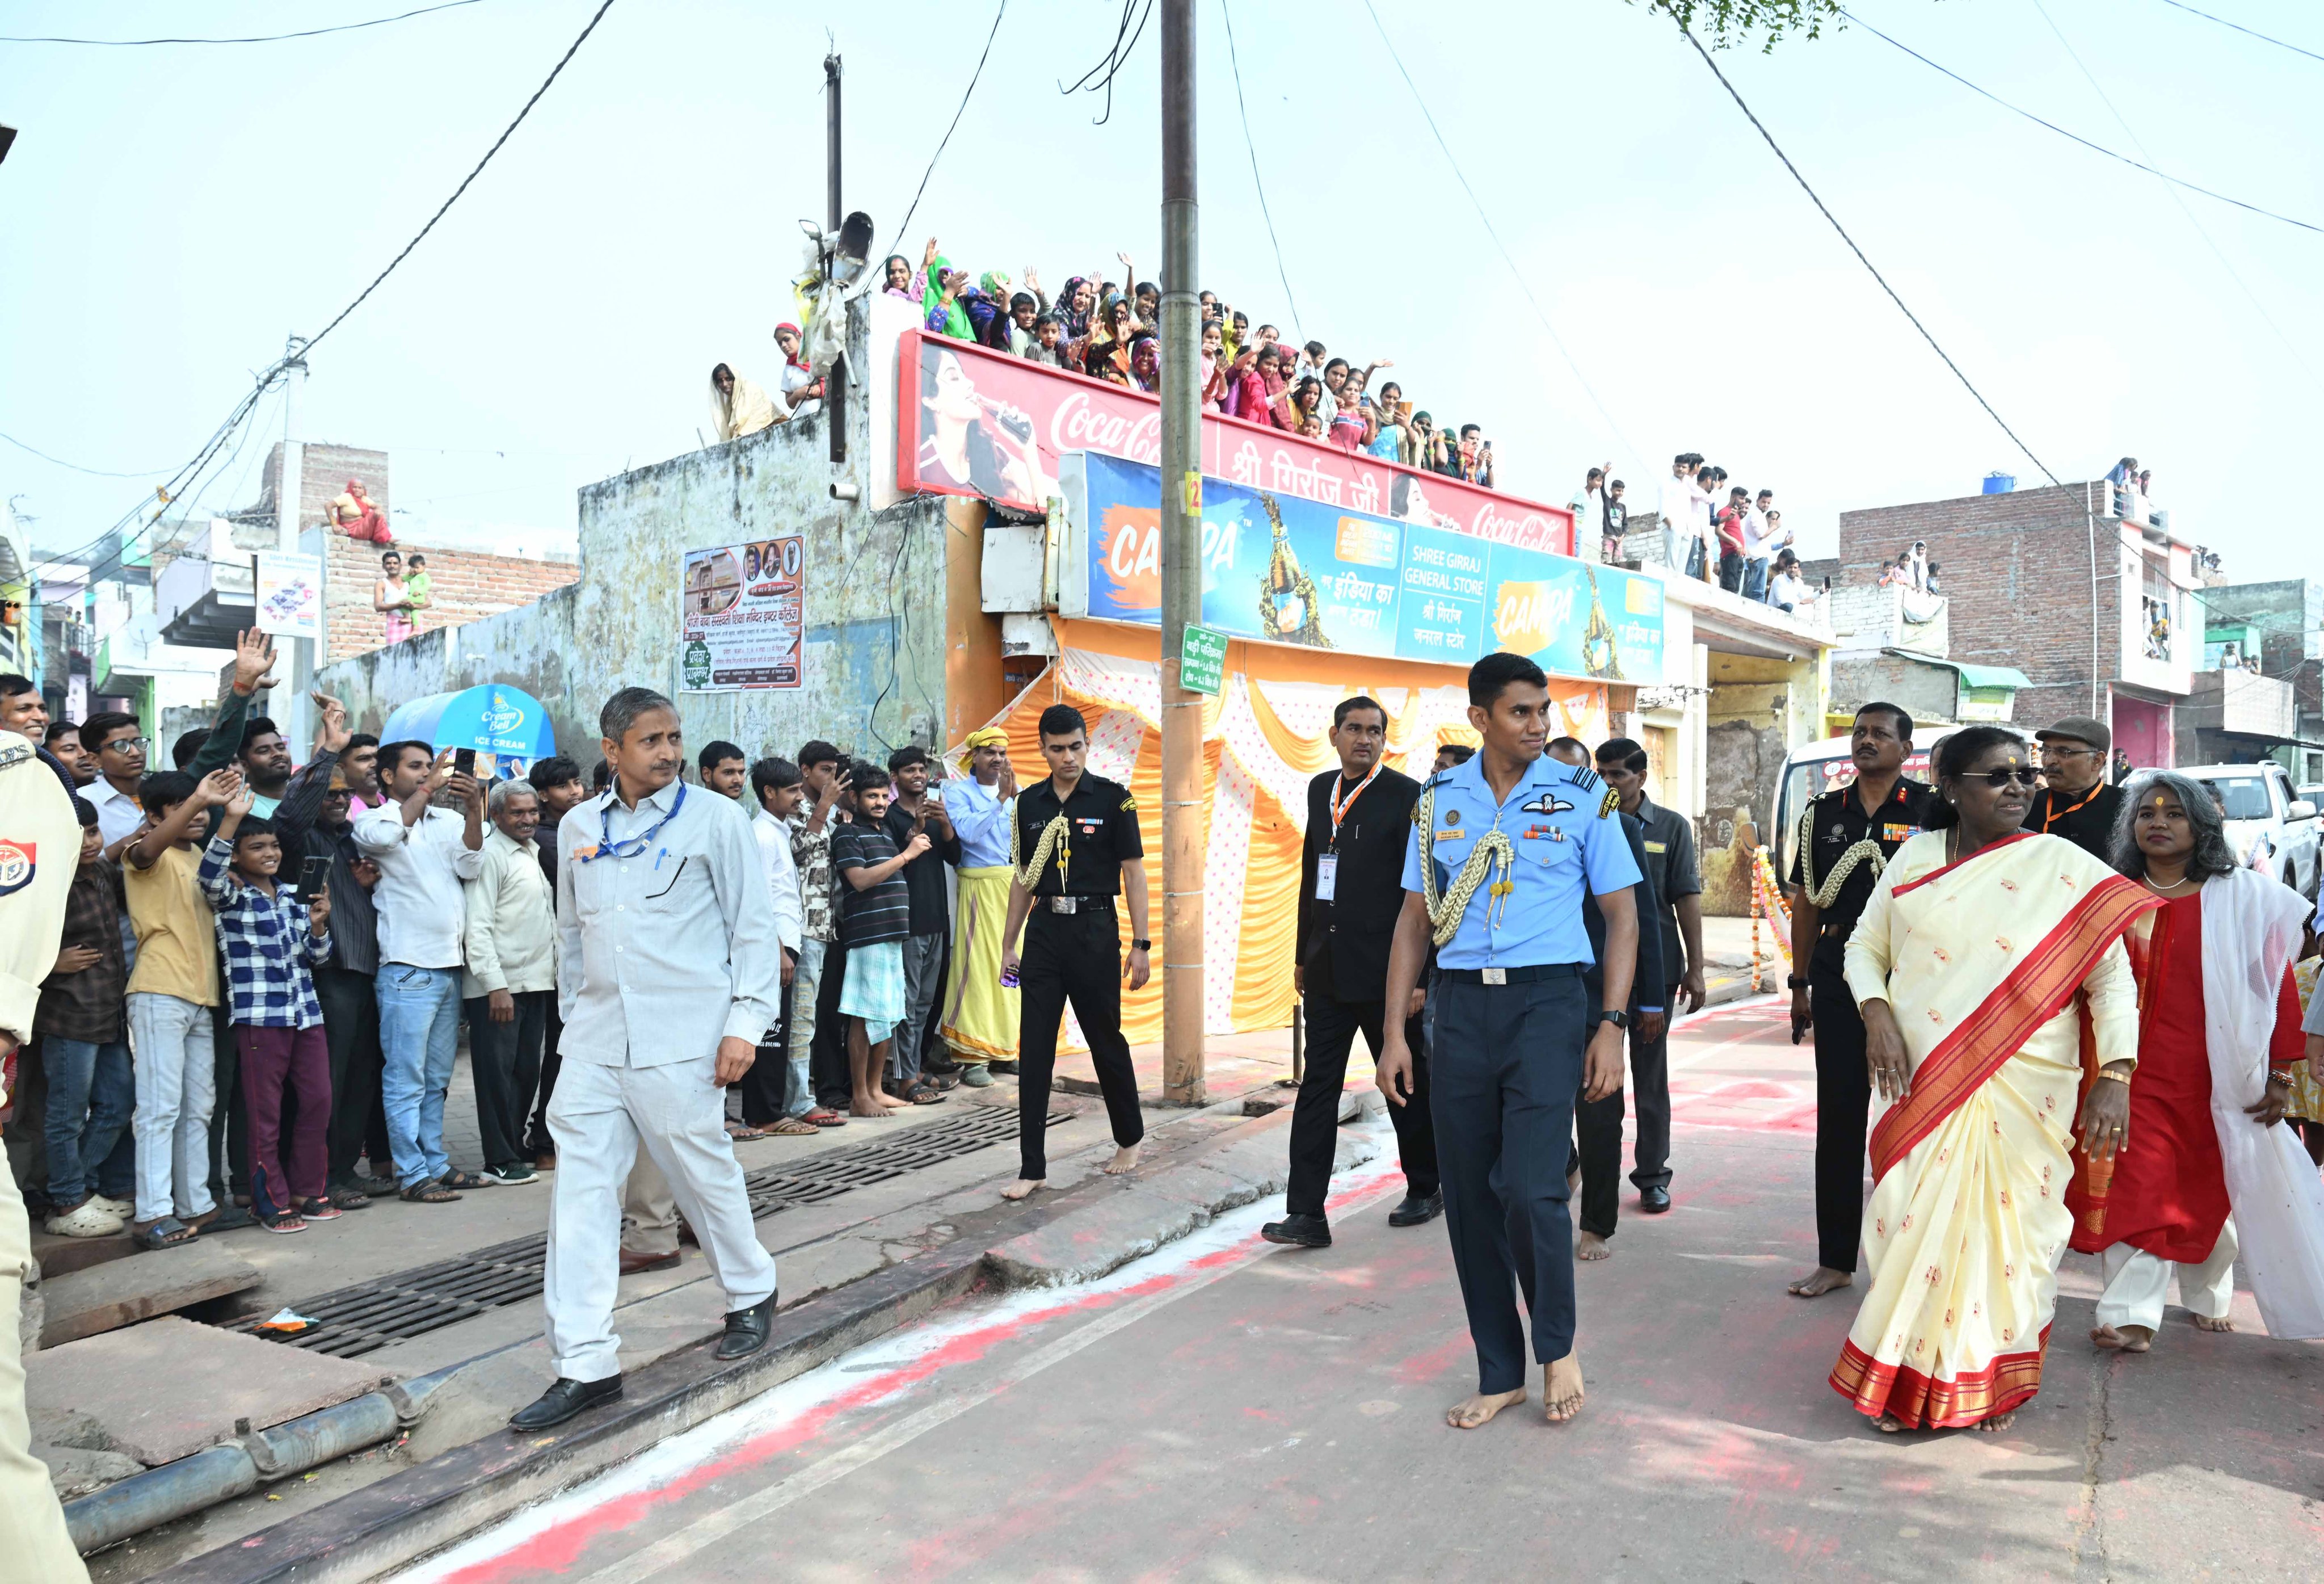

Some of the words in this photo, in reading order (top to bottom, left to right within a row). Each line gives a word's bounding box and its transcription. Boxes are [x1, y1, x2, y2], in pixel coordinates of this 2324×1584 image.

[1231, 440, 1262, 486] श्री
[1349, 472, 1379, 514] जी
[1472, 503, 1561, 553] Coca-Cola
[1111, 524, 1238, 578] CAPA
[1412, 545, 1445, 566] SHREE
[1446, 553, 1481, 573] GIRRAJ
[1334, 572, 1375, 602] इंडिया
[1376, 584, 1395, 604] का
[1404, 567, 1451, 591] GENERAL
[1452, 576, 1484, 596] STORE
[687, 613, 700, 628] श्रीजी
[700, 617, 711, 627] बाबा
[711, 611, 731, 627] सरस्वती
[732, 610, 744, 624] शिक्षा
[746, 608, 763, 624] मन्दिर
[764, 611, 777, 624] इण्टर
[778, 604, 798, 621] कॉलेज
[1422, 599, 1435, 620] श्री
[1437, 601, 1462, 624] गिर्राज
[1498, 586, 1574, 637] CAMPA
[1186, 639, 1199, 657] बड़ी
[1201, 642, 1223, 659] परिक्रमा
[1414, 628, 1443, 647] जनरल
[1446, 628, 1466, 650] स्टोर
[689, 646, 706, 665] प्रवेश
[481, 711, 516, 722] Cream
[489, 720, 510, 731] Bell
[475, 736, 490, 745] ICE
[492, 738, 526, 750] CREAM
